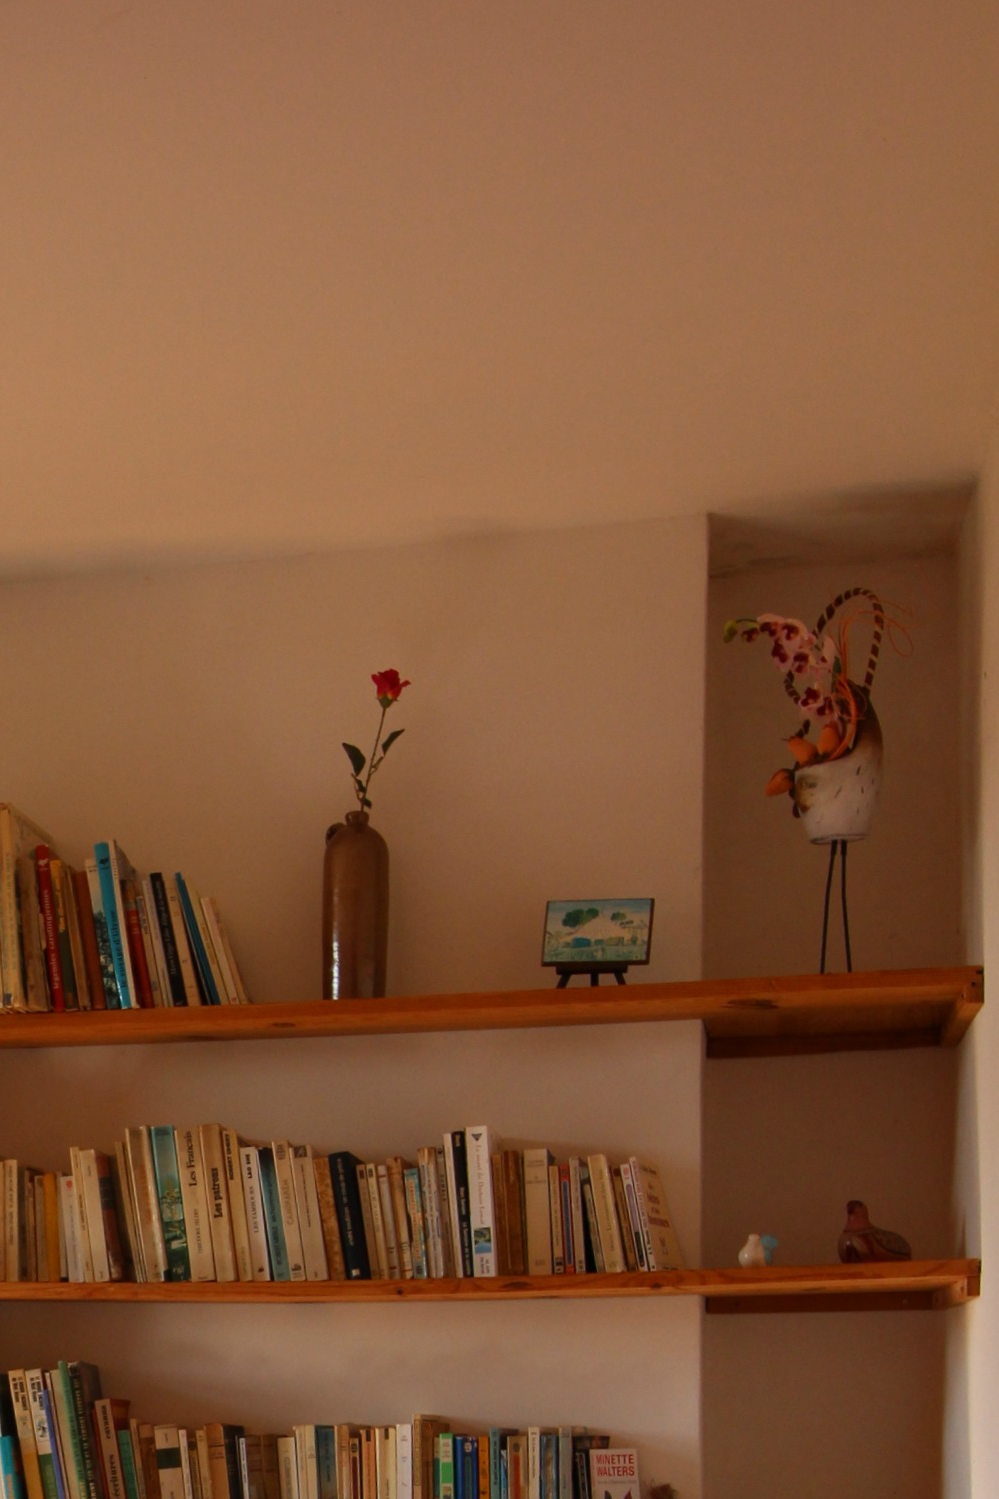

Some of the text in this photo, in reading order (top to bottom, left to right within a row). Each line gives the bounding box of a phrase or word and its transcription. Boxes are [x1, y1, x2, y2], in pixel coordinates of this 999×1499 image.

[41, 887, 60, 989] légendes carolingiennes
[187, 1170, 197, 1186] Les
[210, 1167, 222, 1218] Les patrons
[100, 1404, 111, 1439] cavanna
[106, 1453, 120, 1497] écritures
[596, 1454, 634, 1465] MINETTE
[597, 1466, 635, 1477] WALTERS
